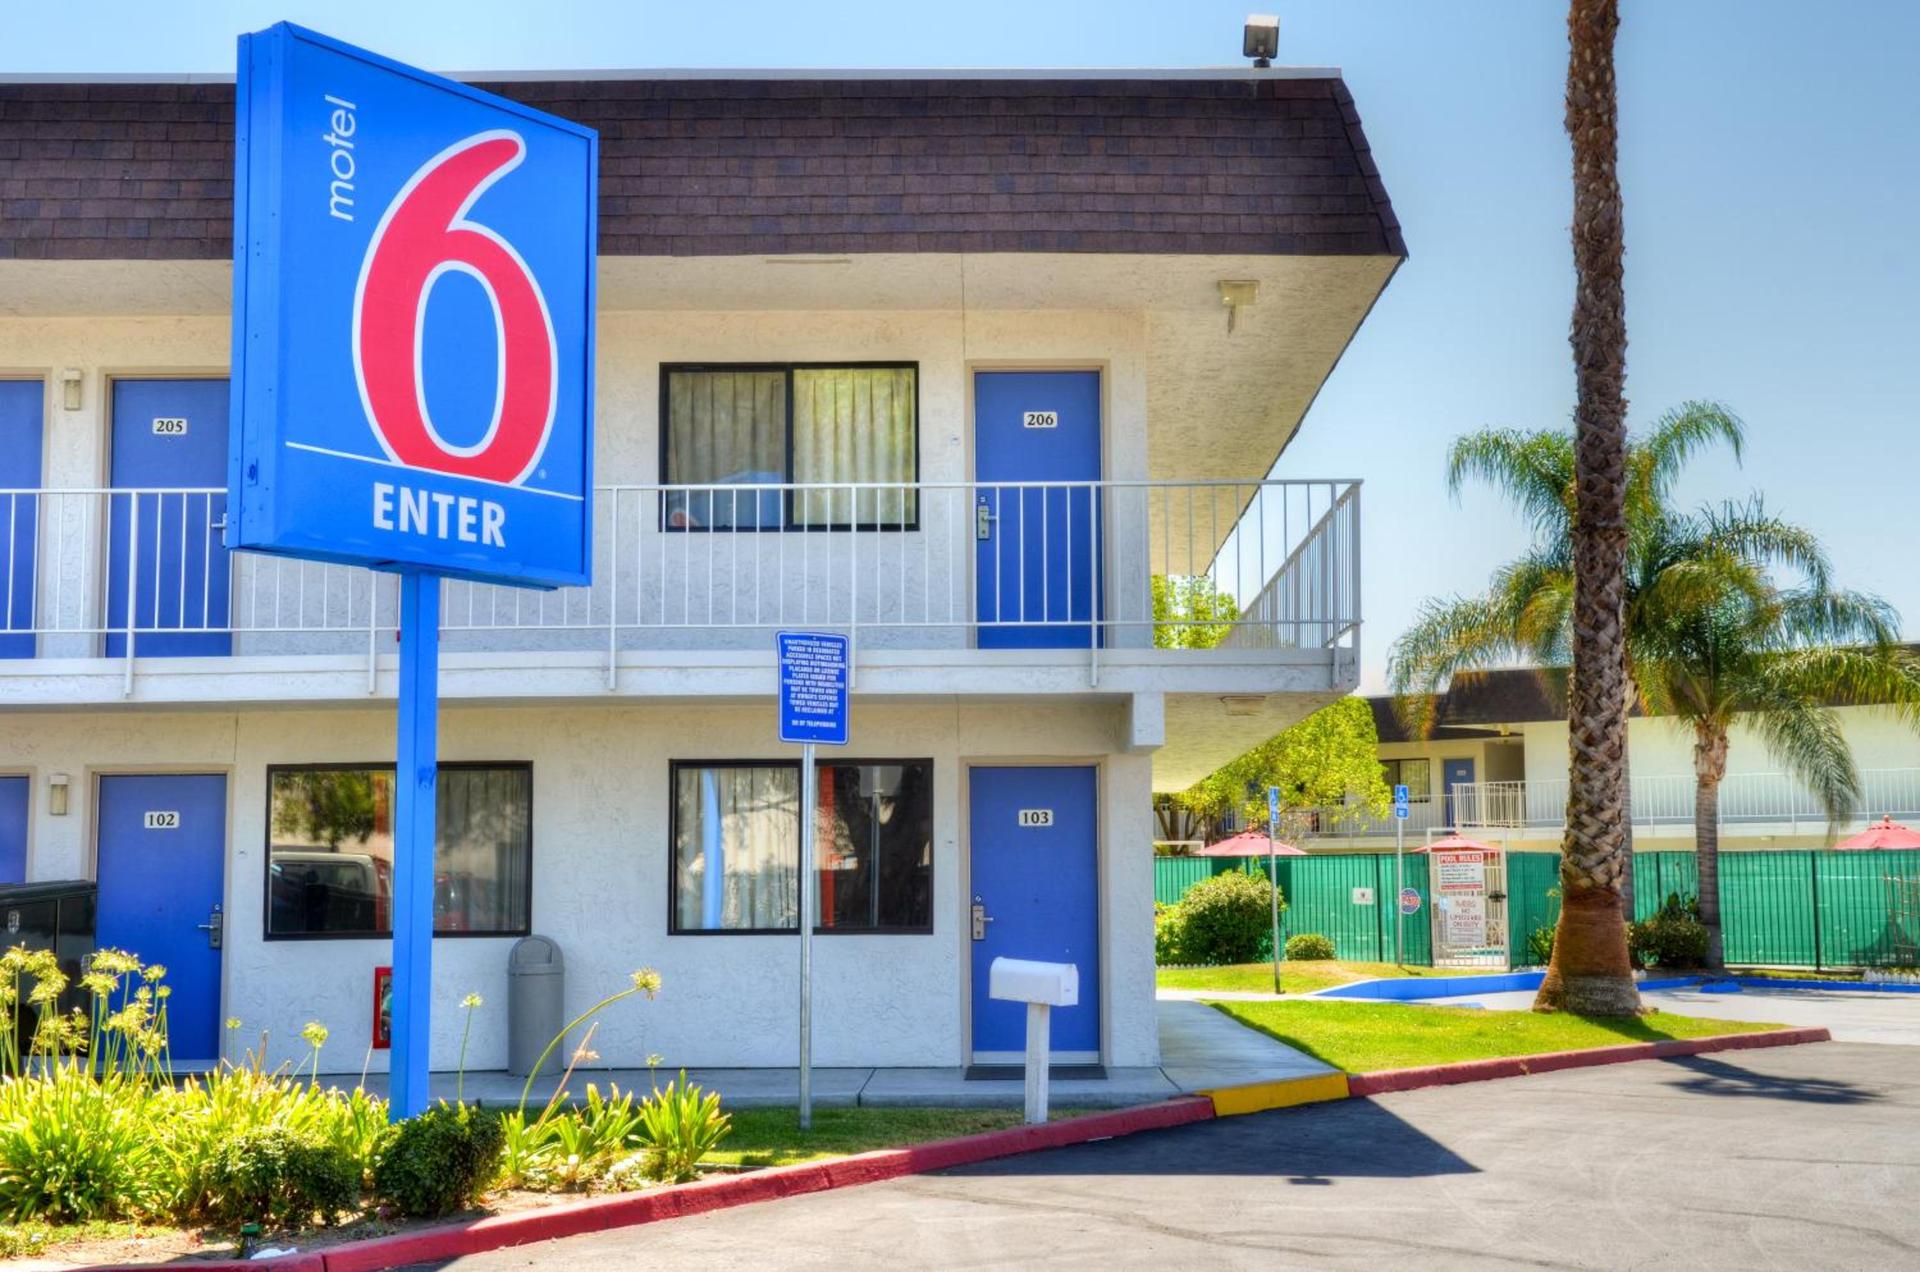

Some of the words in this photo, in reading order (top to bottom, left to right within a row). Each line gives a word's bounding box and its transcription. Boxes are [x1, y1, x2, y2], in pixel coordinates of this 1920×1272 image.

[323, 94, 356, 222] motel
[352, 129, 558, 487] 6
[156, 420, 183, 432] 205
[1027, 414, 1054, 426] 206
[373, 482, 506, 548] ENTER
[150, 814, 175, 826] 102
[1024, 812, 1049, 824] 103
